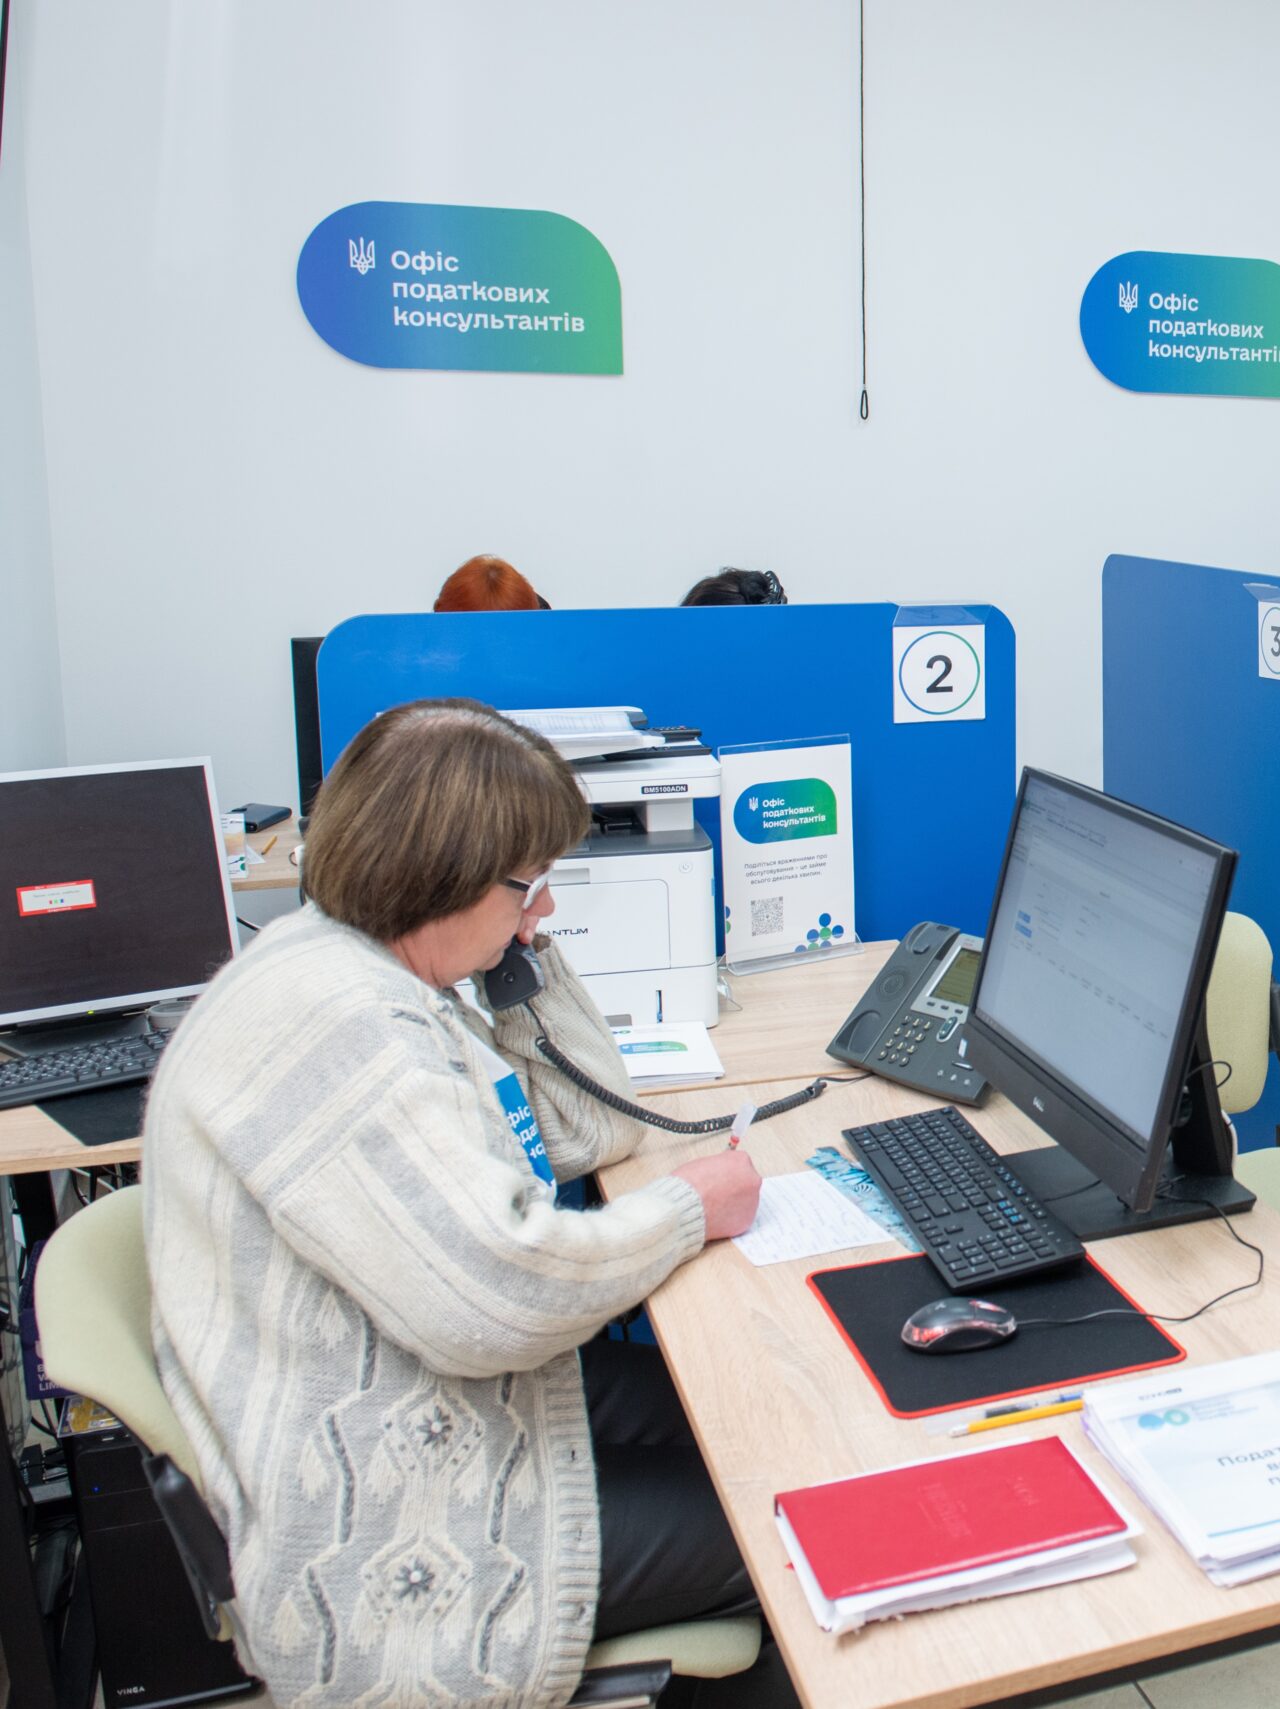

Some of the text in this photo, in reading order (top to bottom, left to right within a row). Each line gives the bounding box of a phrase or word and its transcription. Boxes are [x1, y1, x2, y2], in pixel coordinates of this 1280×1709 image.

[390, 250, 460, 275] Офіс
[392, 281, 551, 304] податкових
[1148, 292, 1199, 314] Офіс
[393, 306, 585, 333] консультантів
[1148, 319, 1265, 339] податкових
[926, 654, 953, 694] 2
[643, 785, 687, 794] BM5100ADN
[762, 797, 785, 808] Офіс
[762, 805, 815, 818] податкових
[763, 813, 826, 829] консультантів
